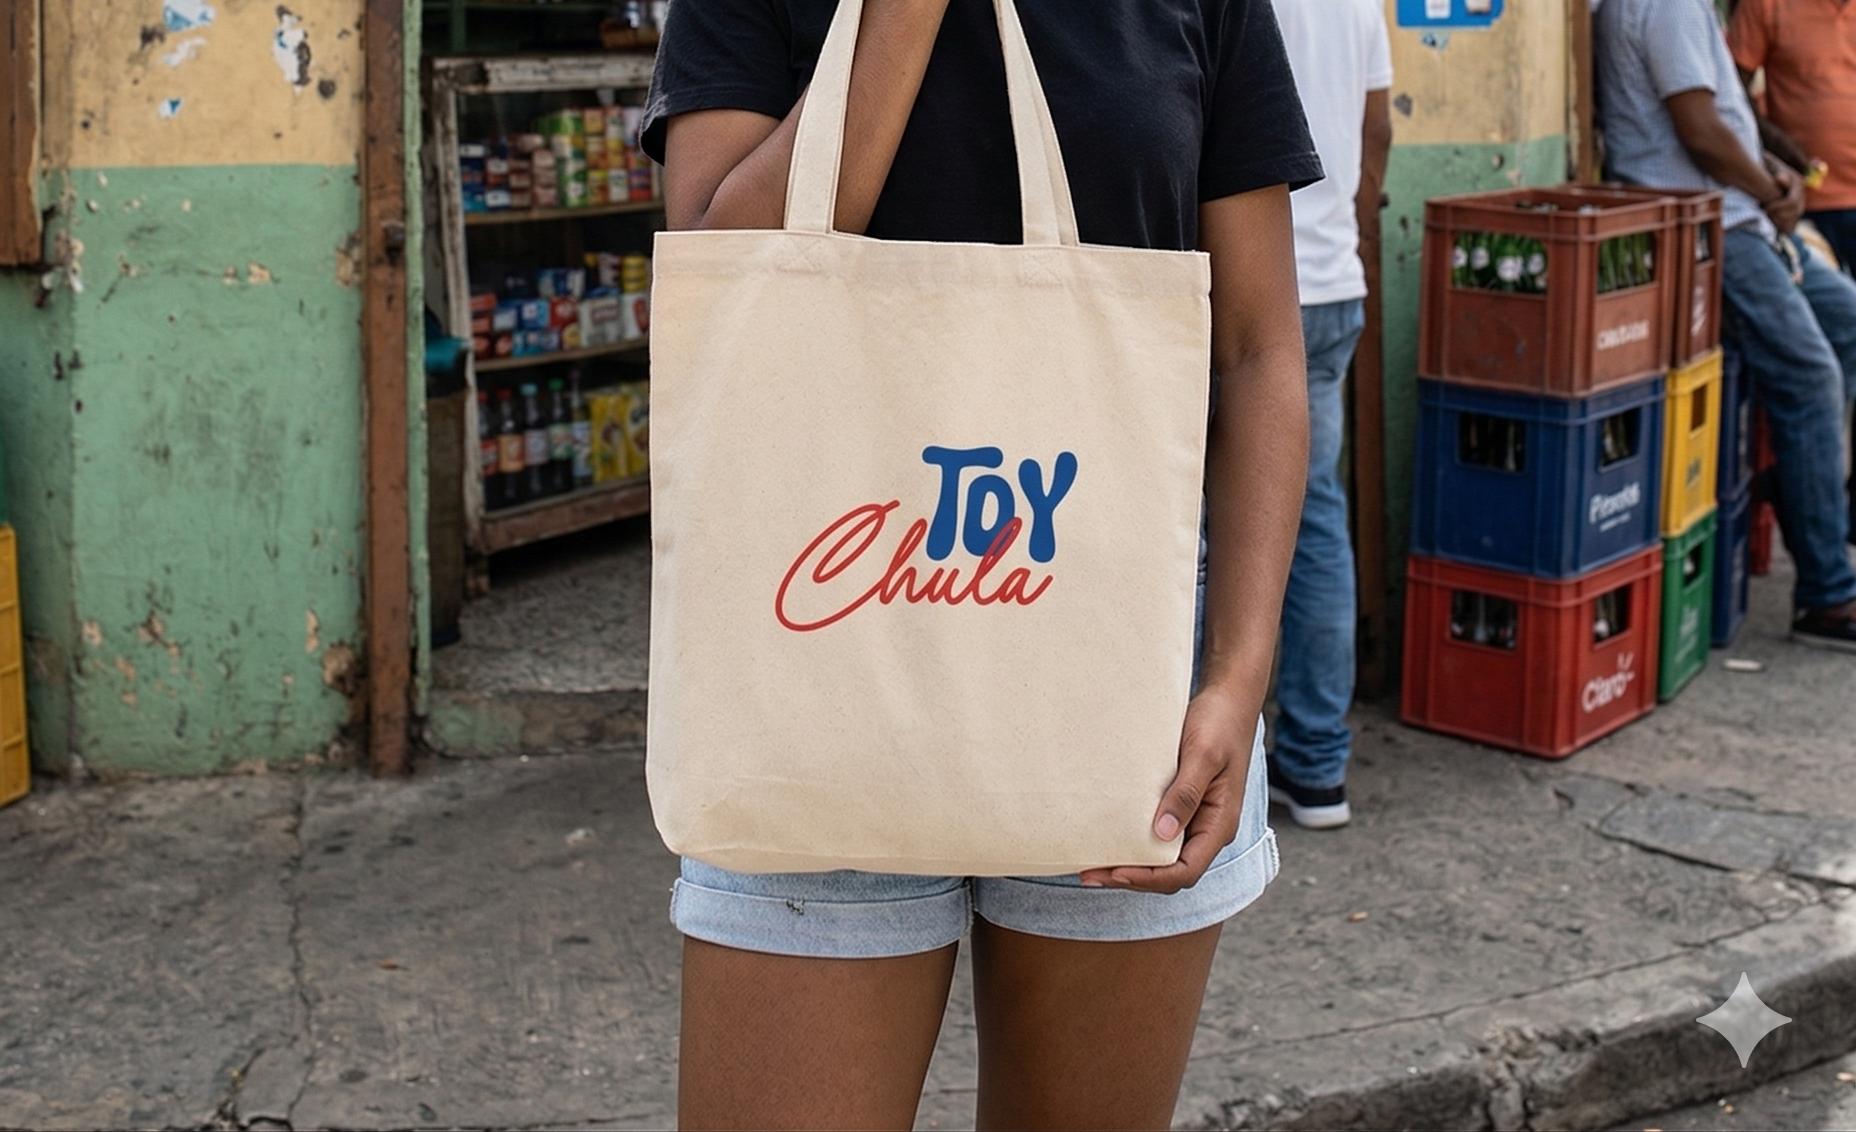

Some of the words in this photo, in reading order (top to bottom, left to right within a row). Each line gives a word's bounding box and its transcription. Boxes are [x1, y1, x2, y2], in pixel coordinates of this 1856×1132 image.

[921, 445, 1078, 564] TOY
[774, 498, 1054, 633] Chula
[1582, 671, 1628, 713] Claro
